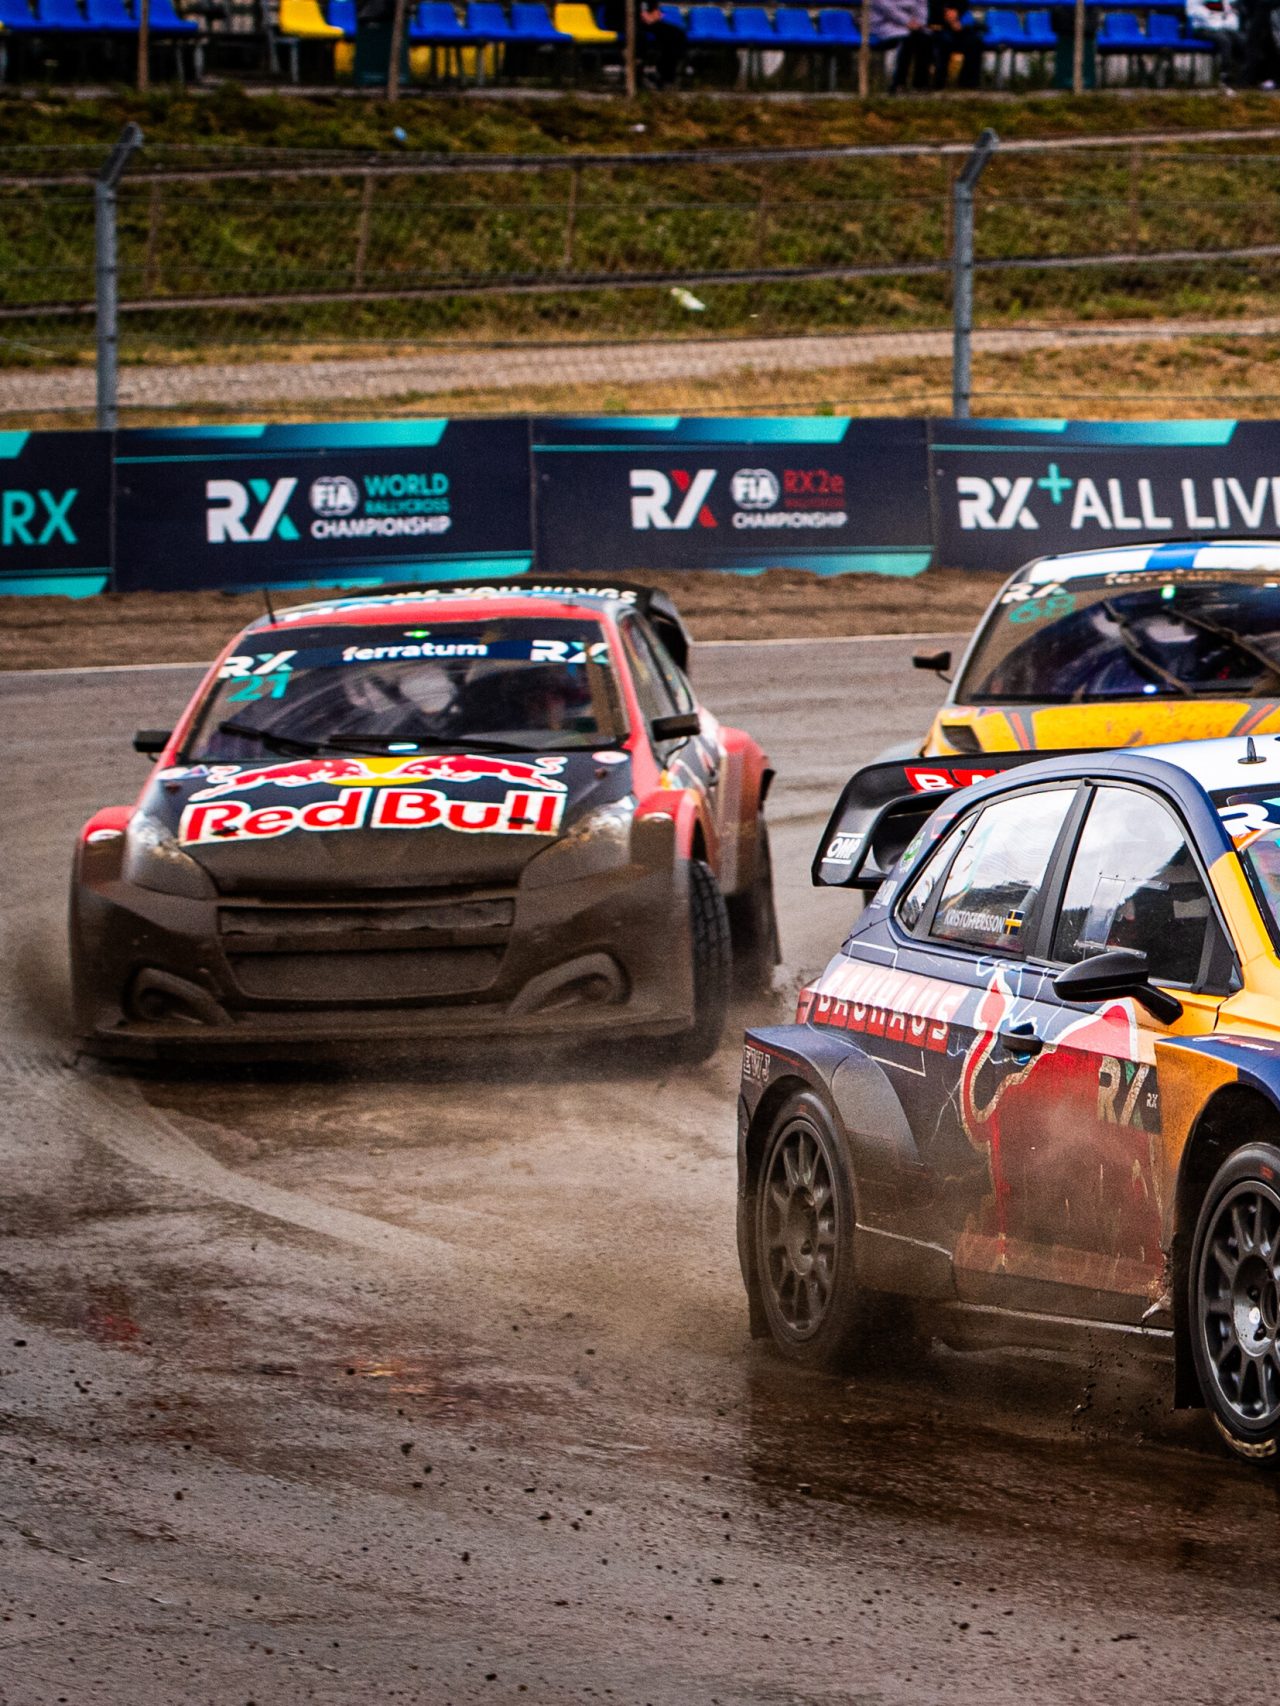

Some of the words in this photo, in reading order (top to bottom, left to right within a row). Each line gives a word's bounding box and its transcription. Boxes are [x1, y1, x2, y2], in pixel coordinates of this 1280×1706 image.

[364, 473, 450, 497] WORLD
[732, 475, 777, 502] FIA
[783, 469, 844, 493] RX2e
[311, 483, 353, 508] FIA
[629, 468, 718, 530] RX
[1071, 478, 1173, 530] ALL
[2, 489, 79, 546] RX
[206, 477, 300, 543] RX
[732, 511, 848, 529] CHAMPIONSHIP
[310, 516, 452, 539] CHAMPIONSHIP
[218, 651, 298, 679] RX
[342, 643, 488, 662] ferratum
[530, 641, 609, 665] RX
[228, 673, 290, 702] 21
[178, 787, 371, 846] Red
[372, 787, 567, 836] Bull
[827, 837, 861, 859] OMP
[943, 909, 1006, 934] KRISTOFFERSSON
